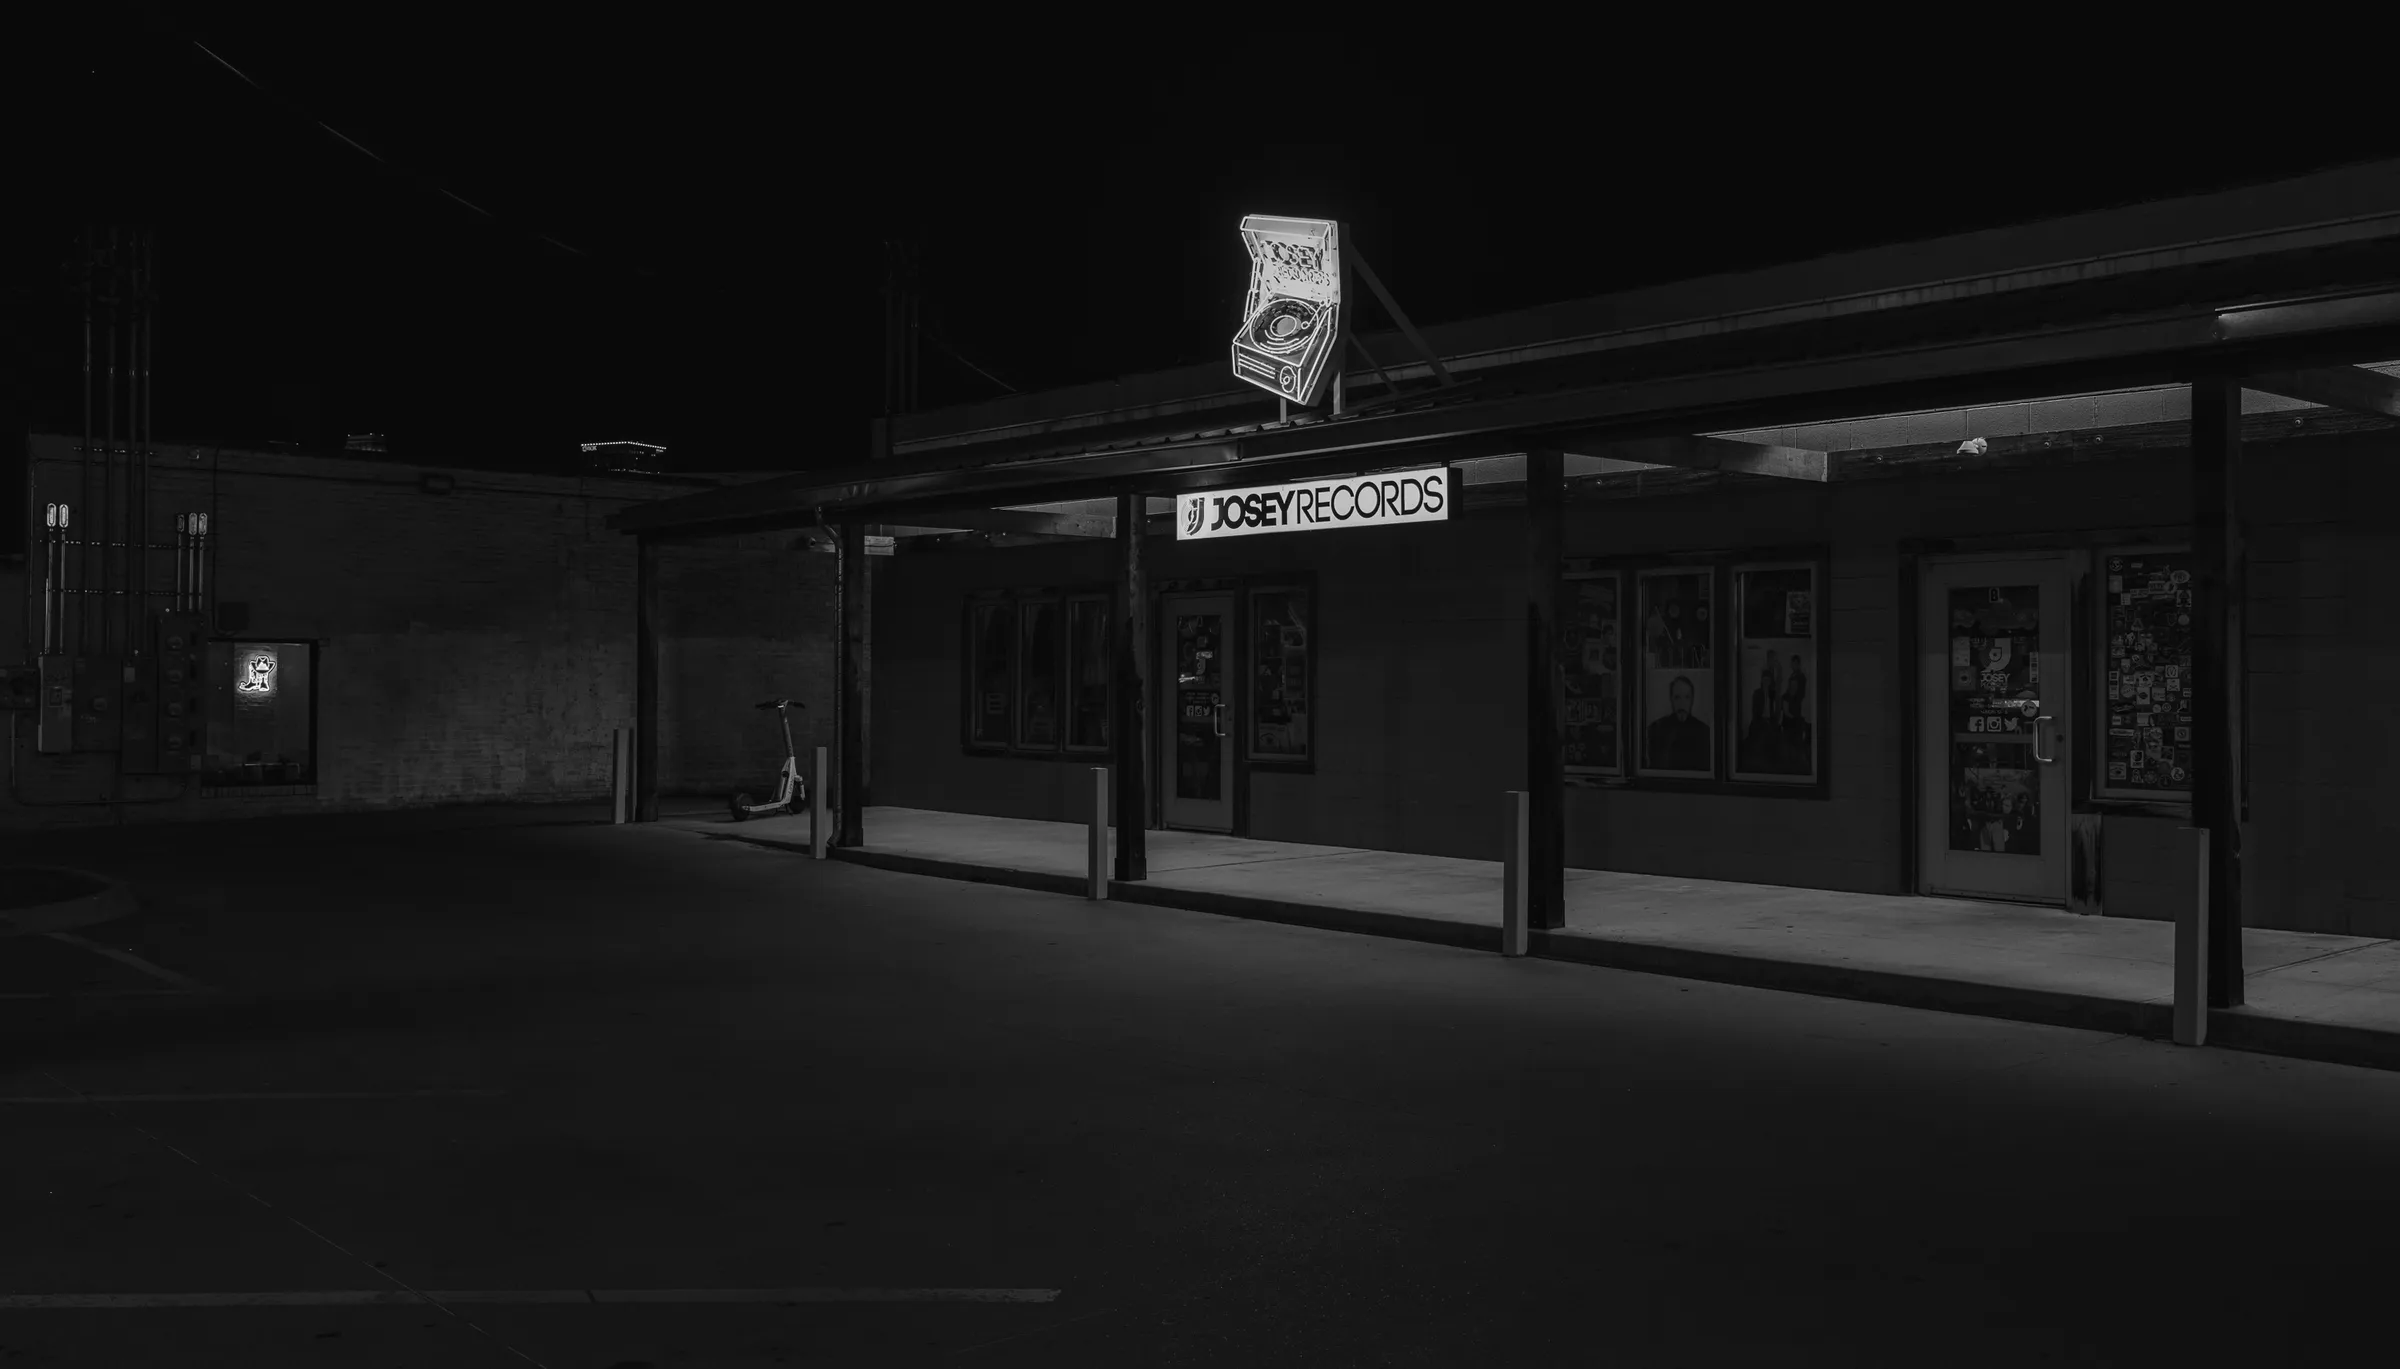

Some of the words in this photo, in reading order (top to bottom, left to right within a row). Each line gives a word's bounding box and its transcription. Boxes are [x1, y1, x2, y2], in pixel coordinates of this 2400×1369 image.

[1260, 239, 1321, 271] JOSEY
[1211, 490, 1295, 532] JOSEY
[1297, 476, 1443, 524] RECORDS
